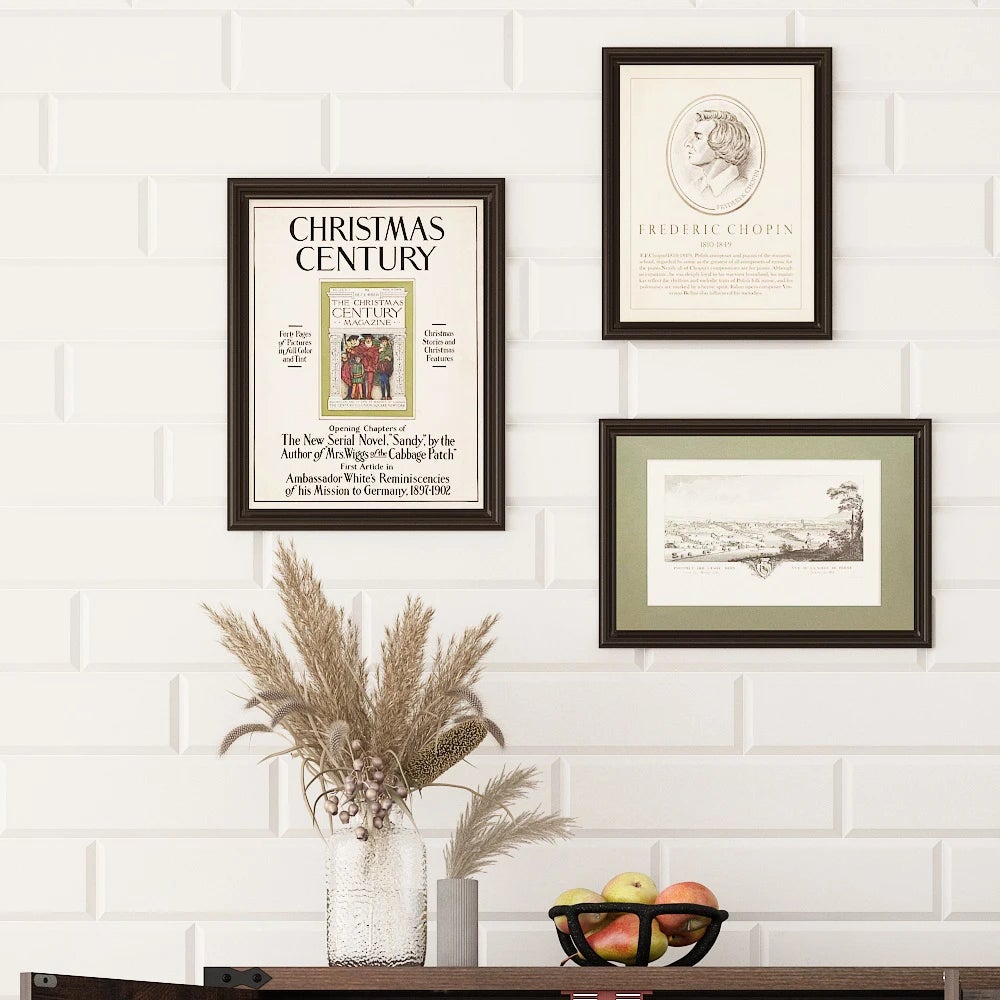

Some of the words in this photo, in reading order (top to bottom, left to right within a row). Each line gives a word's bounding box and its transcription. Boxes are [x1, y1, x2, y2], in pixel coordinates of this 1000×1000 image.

[289, 216, 445, 242] CHRISTMAS
[639, 224, 720, 235] FREDERIC
[727, 224, 792, 235] CHOPIN
[296, 246, 437, 272] CENTURY
[332, 308, 402, 318] CENTURY
[282, 434, 300, 446] The
[303, 434, 324, 446] New
[328, 434, 354, 446] Serial
[429, 434, 439, 448] by
[441, 434, 455, 446] the
[281, 448, 312, 459] Author
[313, 447, 325, 462] of
[344, 448, 369, 462] Wiggs
[389, 448, 427, 463] Cabbage
[286, 473, 342, 483] Ambassador
[344, 473, 376, 483] White's
[285, 485, 297, 497] of
[299, 485, 311, 495] his
[314, 485, 349, 495] Mission
[353, 486, 361, 495] to
[410, 485, 451, 495] 1897-1902
